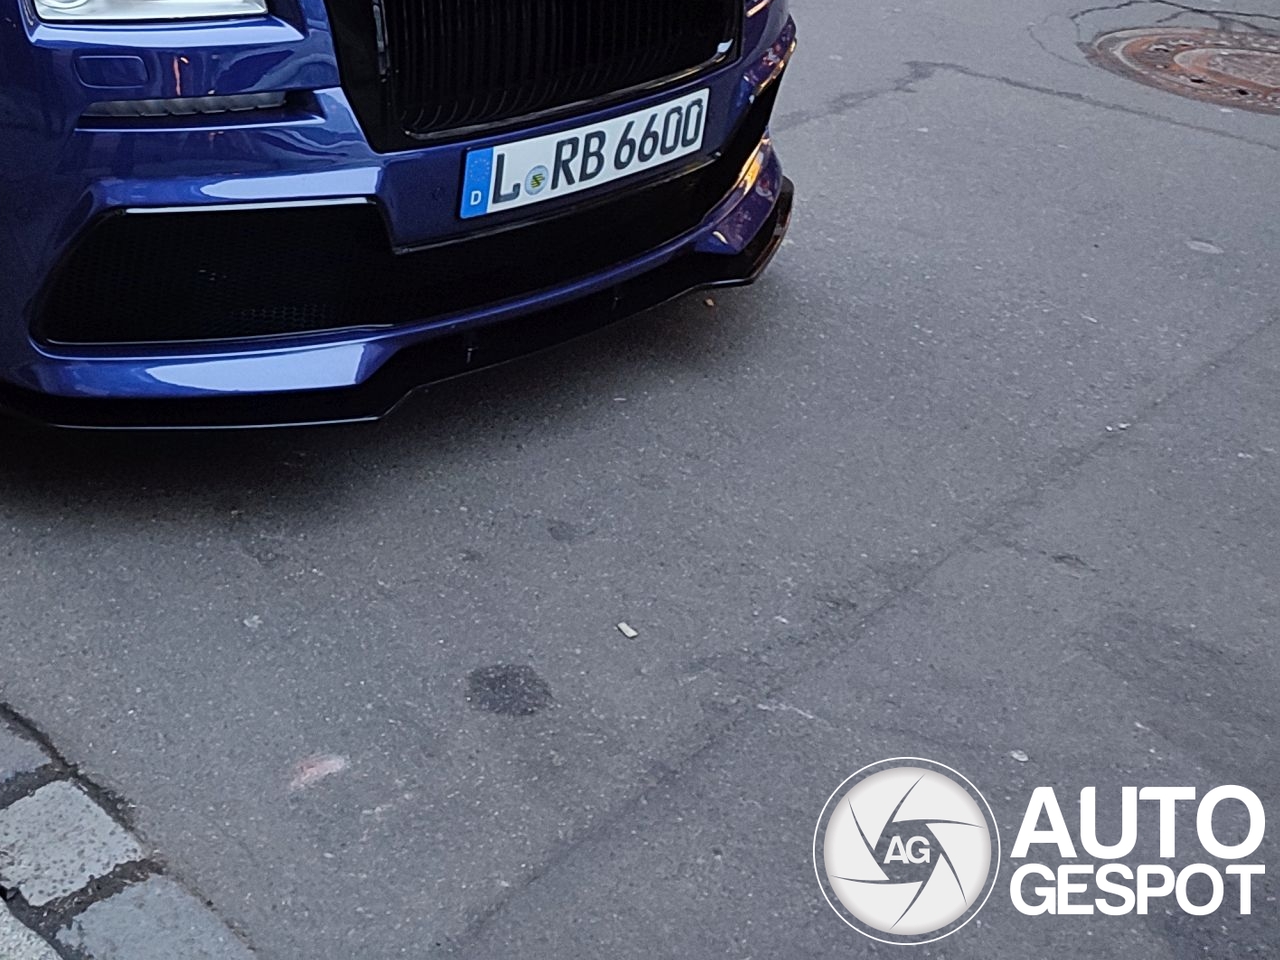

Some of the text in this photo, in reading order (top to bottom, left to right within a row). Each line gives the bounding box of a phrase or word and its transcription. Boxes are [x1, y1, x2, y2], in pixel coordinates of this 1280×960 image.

[492, 97, 704, 204] L RB 6600
[470, 189, 481, 207] D
